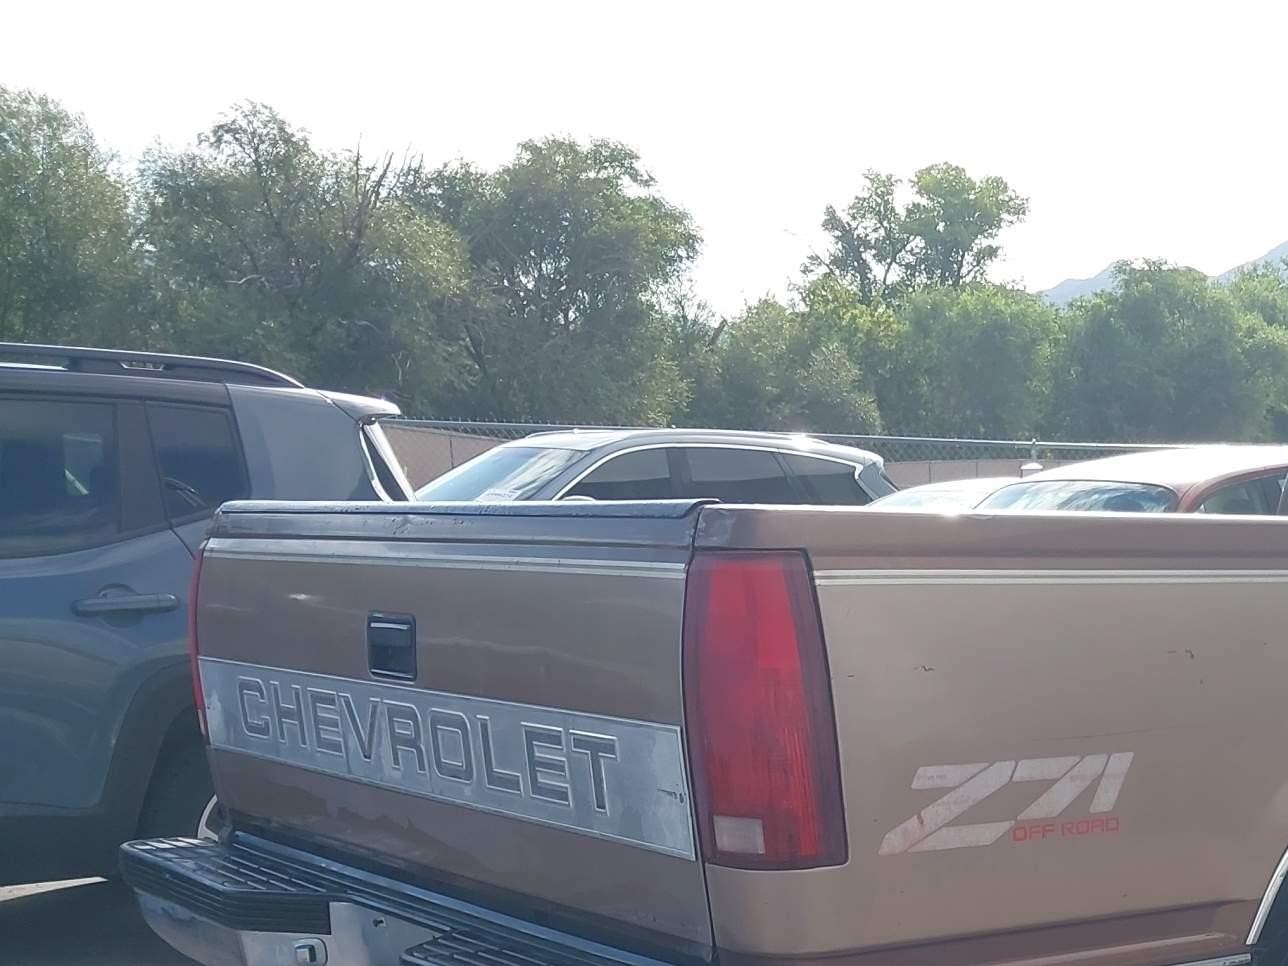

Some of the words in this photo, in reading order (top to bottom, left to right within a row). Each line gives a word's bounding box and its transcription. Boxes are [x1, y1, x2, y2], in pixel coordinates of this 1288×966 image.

[237, 675, 620, 817] CHEVROLET
[878, 751, 1135, 856] Z71
[1012, 823, 1055, 842] OFF
[1061, 816, 1120, 838] ROAD
